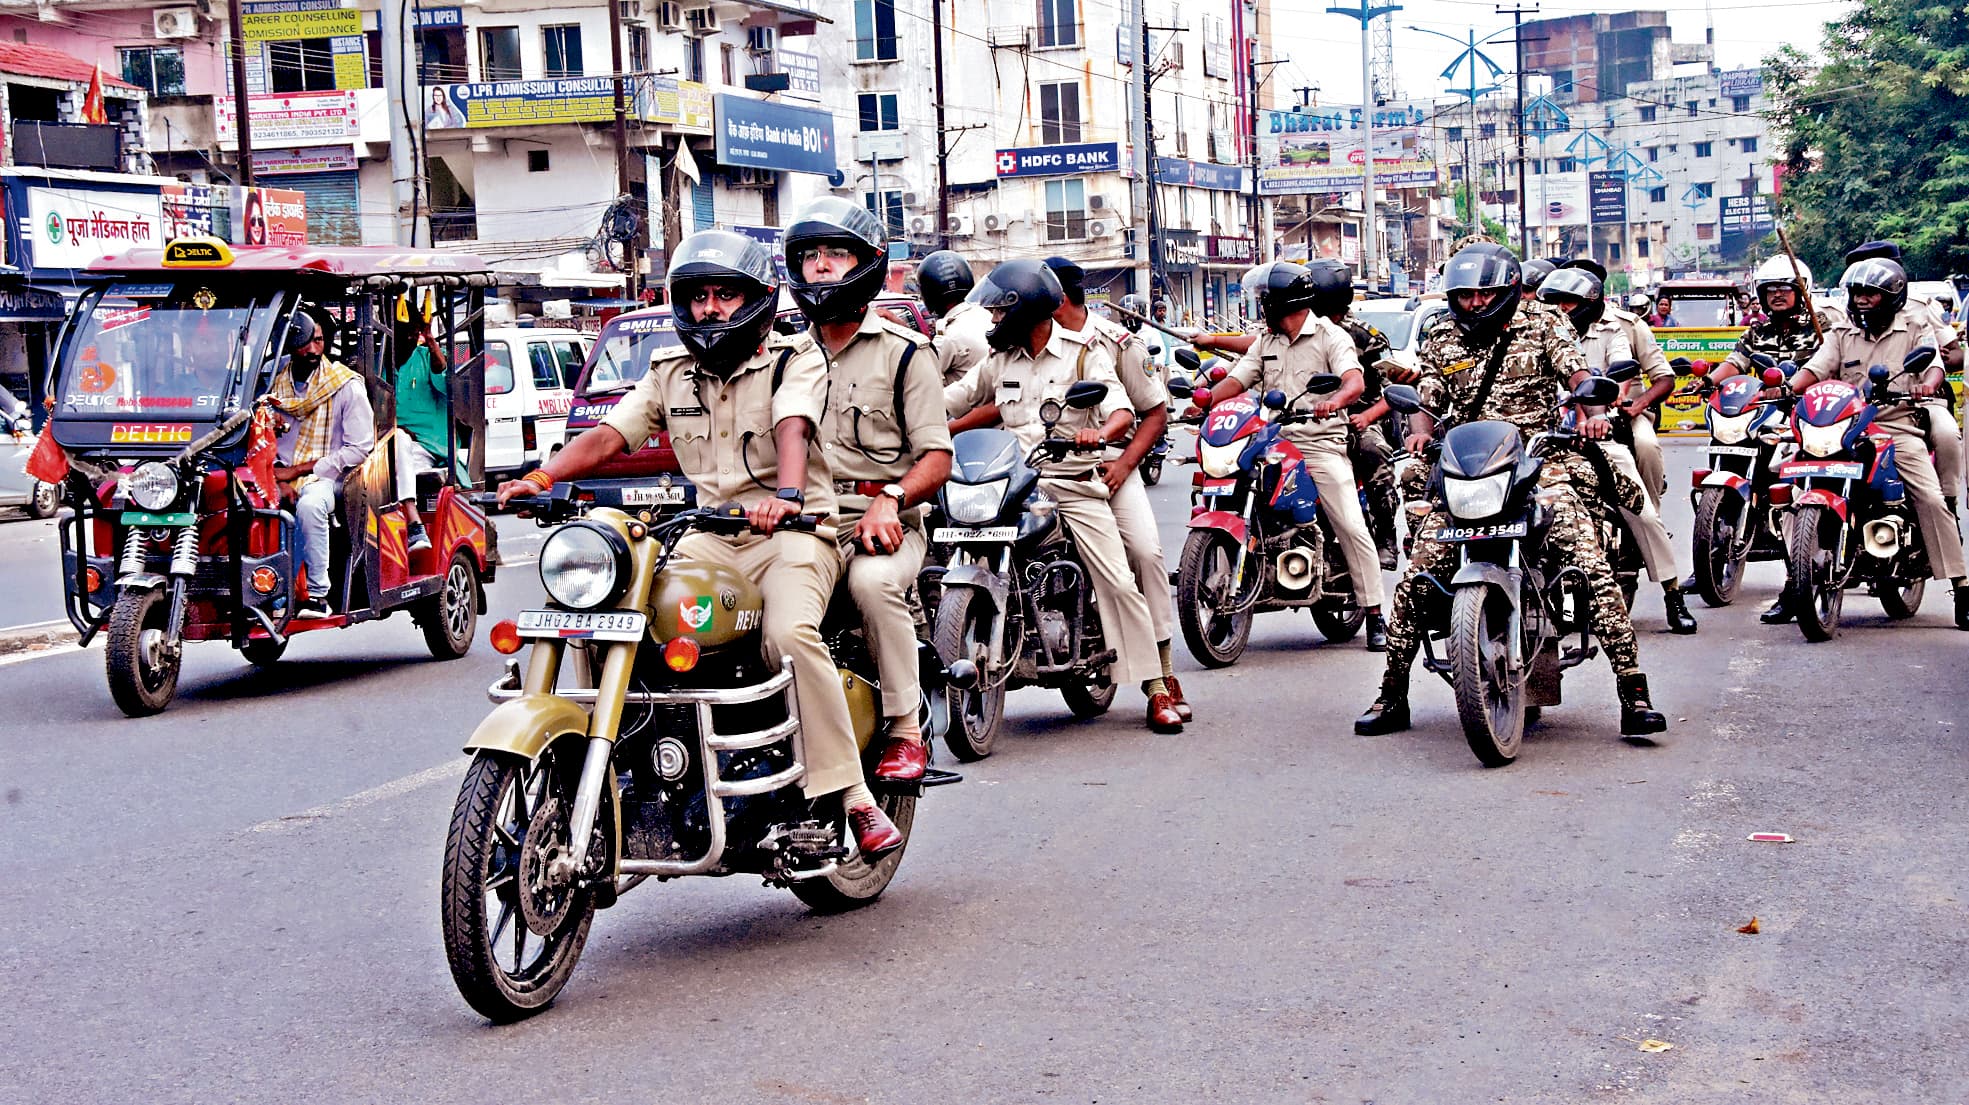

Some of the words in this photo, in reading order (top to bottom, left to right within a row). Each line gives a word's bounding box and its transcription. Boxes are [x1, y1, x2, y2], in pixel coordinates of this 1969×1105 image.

[253, 2, 299, 13] ADMISSION
[284, 10, 356, 23] COUNSELLING
[434, 9, 458, 24] OPEN
[242, 27, 300, 39] ADMISSION
[304, 24, 357, 36] GUIDANCE
[472, 84, 494, 97] LPR
[495, 79, 556, 96] ADMISSION
[249, 111, 289, 120] MARKETING
[290, 110, 312, 118] INDIA
[1270, 110, 1343, 134] Bharat
[1350, 104, 1424, 130] Frm's
[764, 124, 781, 144] Bank
[781, 127, 788, 145] of
[788, 128, 802, 147] India
[803, 126, 822, 153] BOI
[1021, 154, 1062, 168] HDFC
[1066, 150, 1109, 165] BANK
[66, 218, 89, 247] पूजा
[90, 210, 129, 240] मेडिकल
[131, 212, 151, 244] हॉल
[186, 248, 213, 256] DELTIC
[618, 318, 674, 331] SMILE
[1725, 381, 1748, 395] 34
[1805, 383, 1856, 399] TIGER
[1812, 396, 1841, 412] 17
[1211, 414, 1238, 431] 20
[111, 425, 192, 442] DELTIC
[1488, 523, 1524, 536] 3548
[534, 612, 572, 629] JH02
[575, 614, 593, 629] BA
[597, 615, 635, 631] 2949
